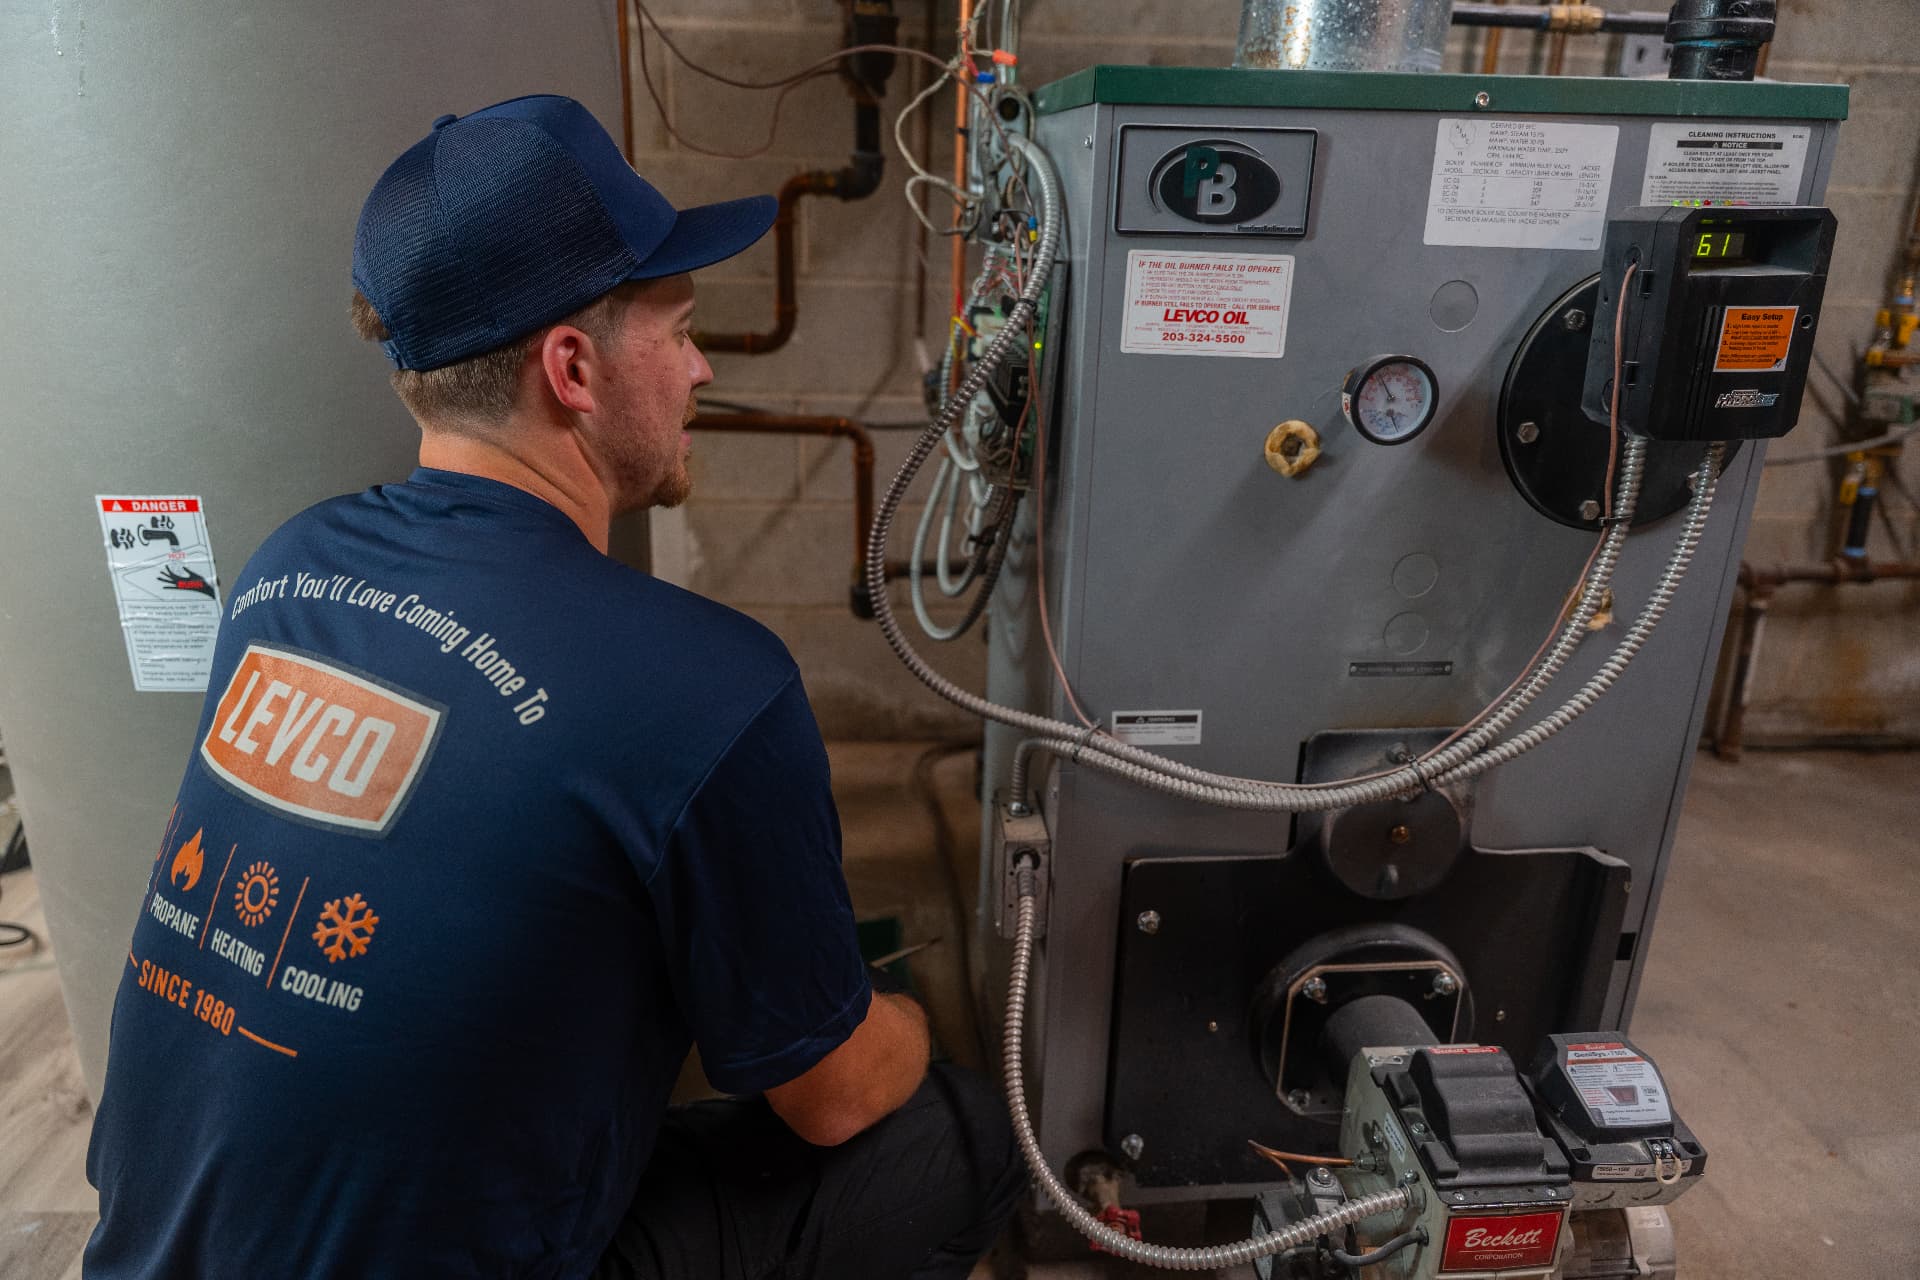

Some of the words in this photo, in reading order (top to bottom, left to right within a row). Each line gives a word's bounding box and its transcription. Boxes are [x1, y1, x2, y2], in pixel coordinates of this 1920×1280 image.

[1697, 234, 1730, 256] 61
[1138, 260, 1145, 268] IF
[1163, 309, 1219, 323] LEVCO
[1223, 312, 1249, 324] OIL
[1162, 332, 1245, 344] 203-324-5500
[132, 501, 186, 511] DANGER
[232, 574, 288, 620] Comfort
[293, 572, 352, 602] You'll
[347, 580, 396, 612] Love
[395, 594, 469, 653] Coming
[461, 632, 527, 697] Home
[513, 688, 550, 726] To
[218, 670, 396, 798] LEVCO
[150, 892, 199, 940] PROPANE
[211, 928, 265, 976] HEATING
[281, 966, 364, 1012] COOLING
[138, 960, 192, 1008] SINCE
[193, 989, 236, 1036] 1980
[1464, 1227, 1543, 1248] Beckett
